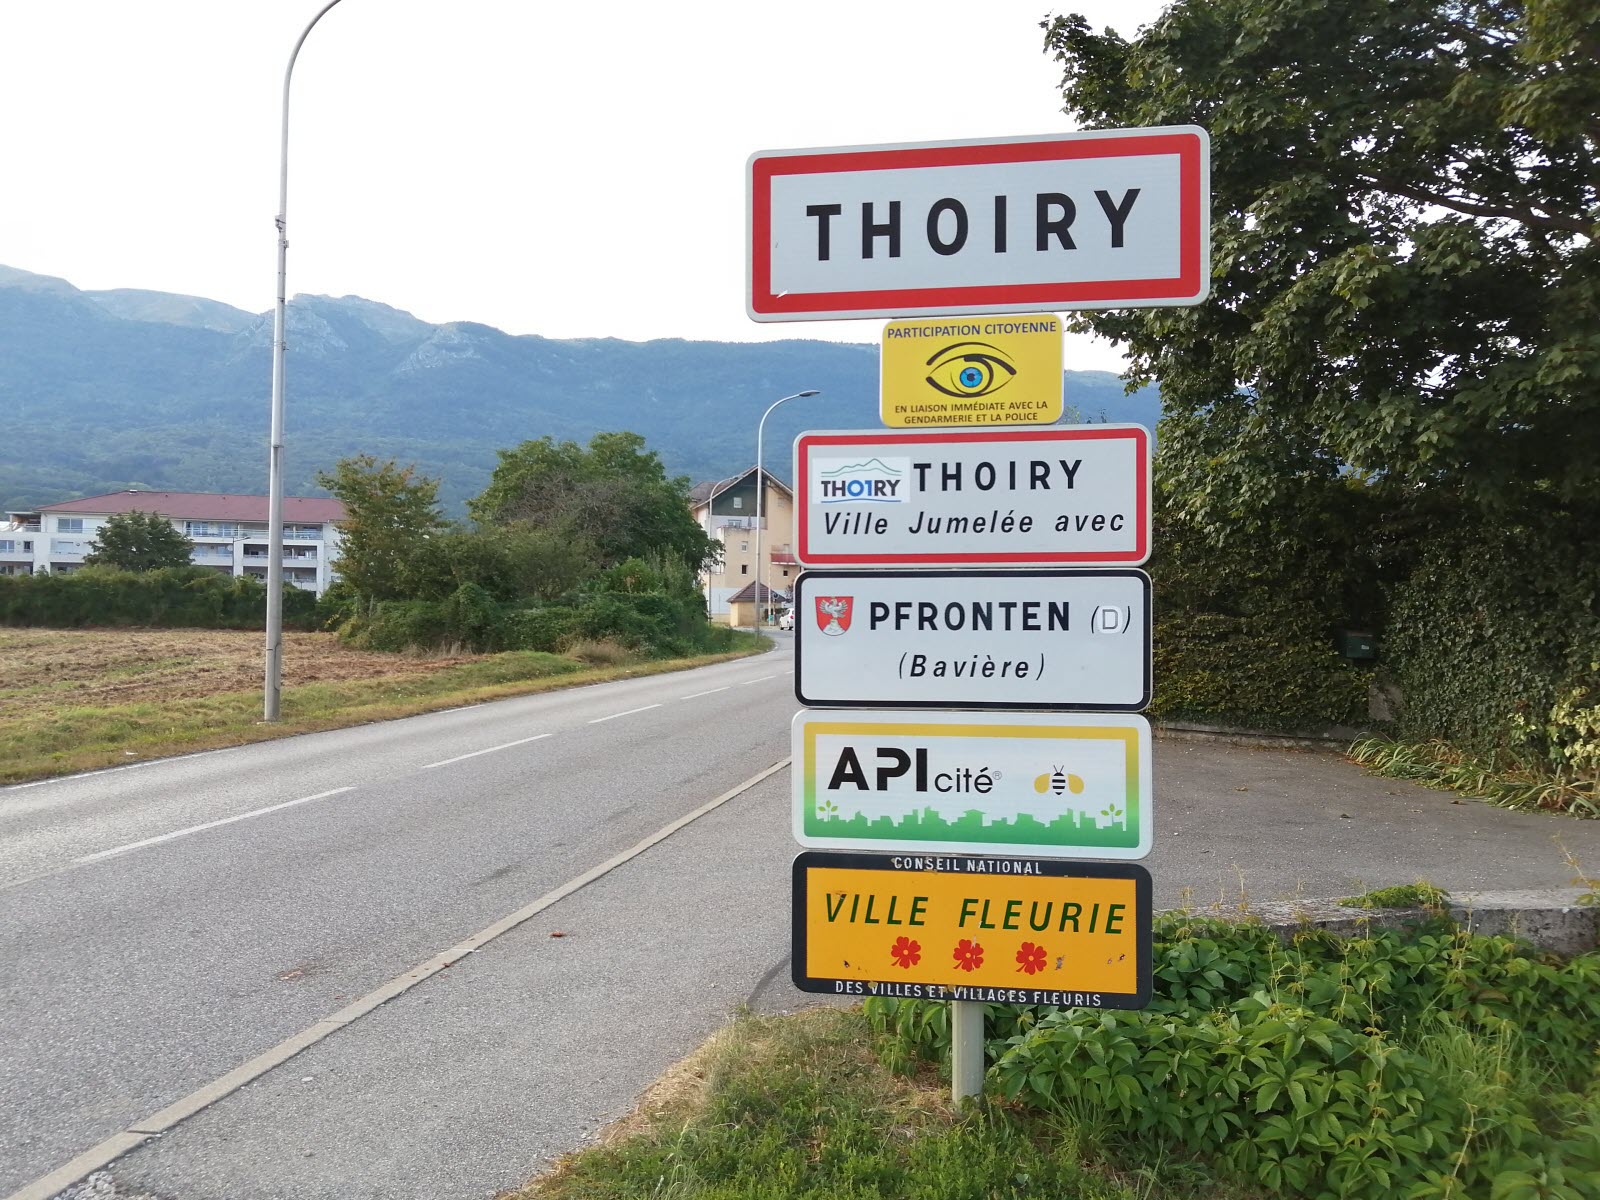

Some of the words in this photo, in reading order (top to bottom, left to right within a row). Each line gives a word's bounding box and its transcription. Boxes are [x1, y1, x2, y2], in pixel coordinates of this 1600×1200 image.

[806, 188, 1141, 261] THOIRY
[887, 325, 980, 339] PARTICIPATION
[984, 321, 1057, 335] CITOYENNE
[895, 405, 907, 413] EN
[910, 404, 947, 413] LIAISON
[951, 401, 1005, 411] IMMÉDIATE
[1008, 401, 1033, 410] AVEC
[1036, 401, 1048, 409] LA
[904, 415, 973, 424] GENDARMERIE
[990, 414, 1002, 422] LA
[1005, 412, 1038, 421] POLICE
[913, 459, 1083, 492] THOIRY
[824, 512, 888, 535] Ville
[908, 510, 1033, 534] Jumelée
[1055, 512, 1124, 531] avec
[869, 602, 1070, 631] PFRONTEN
[1090, 605, 1132, 634] (D)
[898, 652, 1045, 681] (Bavière)
[894, 857, 961, 871] CONSEIL
[967, 860, 1043, 875] NATIONAL
[825, 893, 929, 926] VILLE
[958, 898, 1126, 934] FLEURIE
[835, 980, 864, 994] DES
[871, 982, 922, 998] VILLES
[927, 985, 945, 999] ET
[952, 986, 1027, 1004] VILLAGES
[1032, 990, 1101, 1007] FLEURIS
